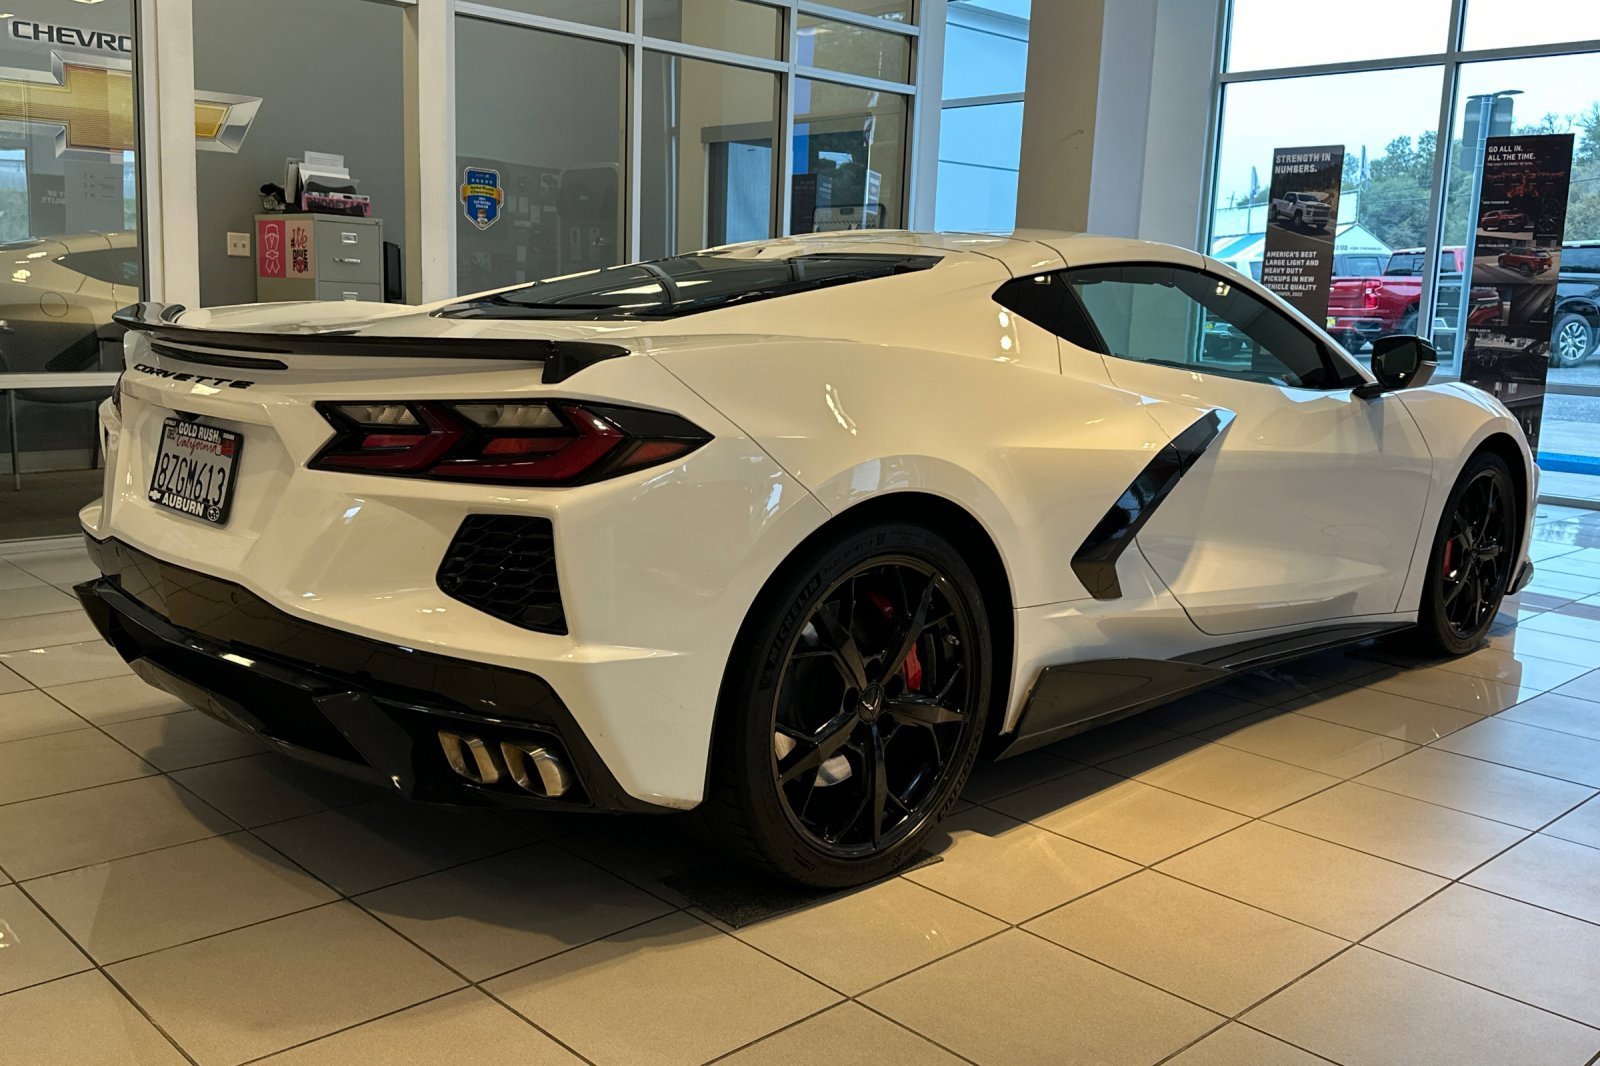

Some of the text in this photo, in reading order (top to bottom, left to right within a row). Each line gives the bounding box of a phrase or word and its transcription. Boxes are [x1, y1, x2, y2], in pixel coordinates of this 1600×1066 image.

[1275, 152, 1331, 164] STRENGTH IN
[1274, 164, 1318, 174] NUMBERS.
[292, 261, 309, 274] FR
[133, 363, 255, 389] CORVETTE
[178, 422, 219, 443] GOLD RUSH
[176, 436, 217, 457] California
[157, 452, 226, 507] 8ZGM613
[162, 492, 205, 517] AUBURN
[769, 573, 823, 665] MICHELIN
